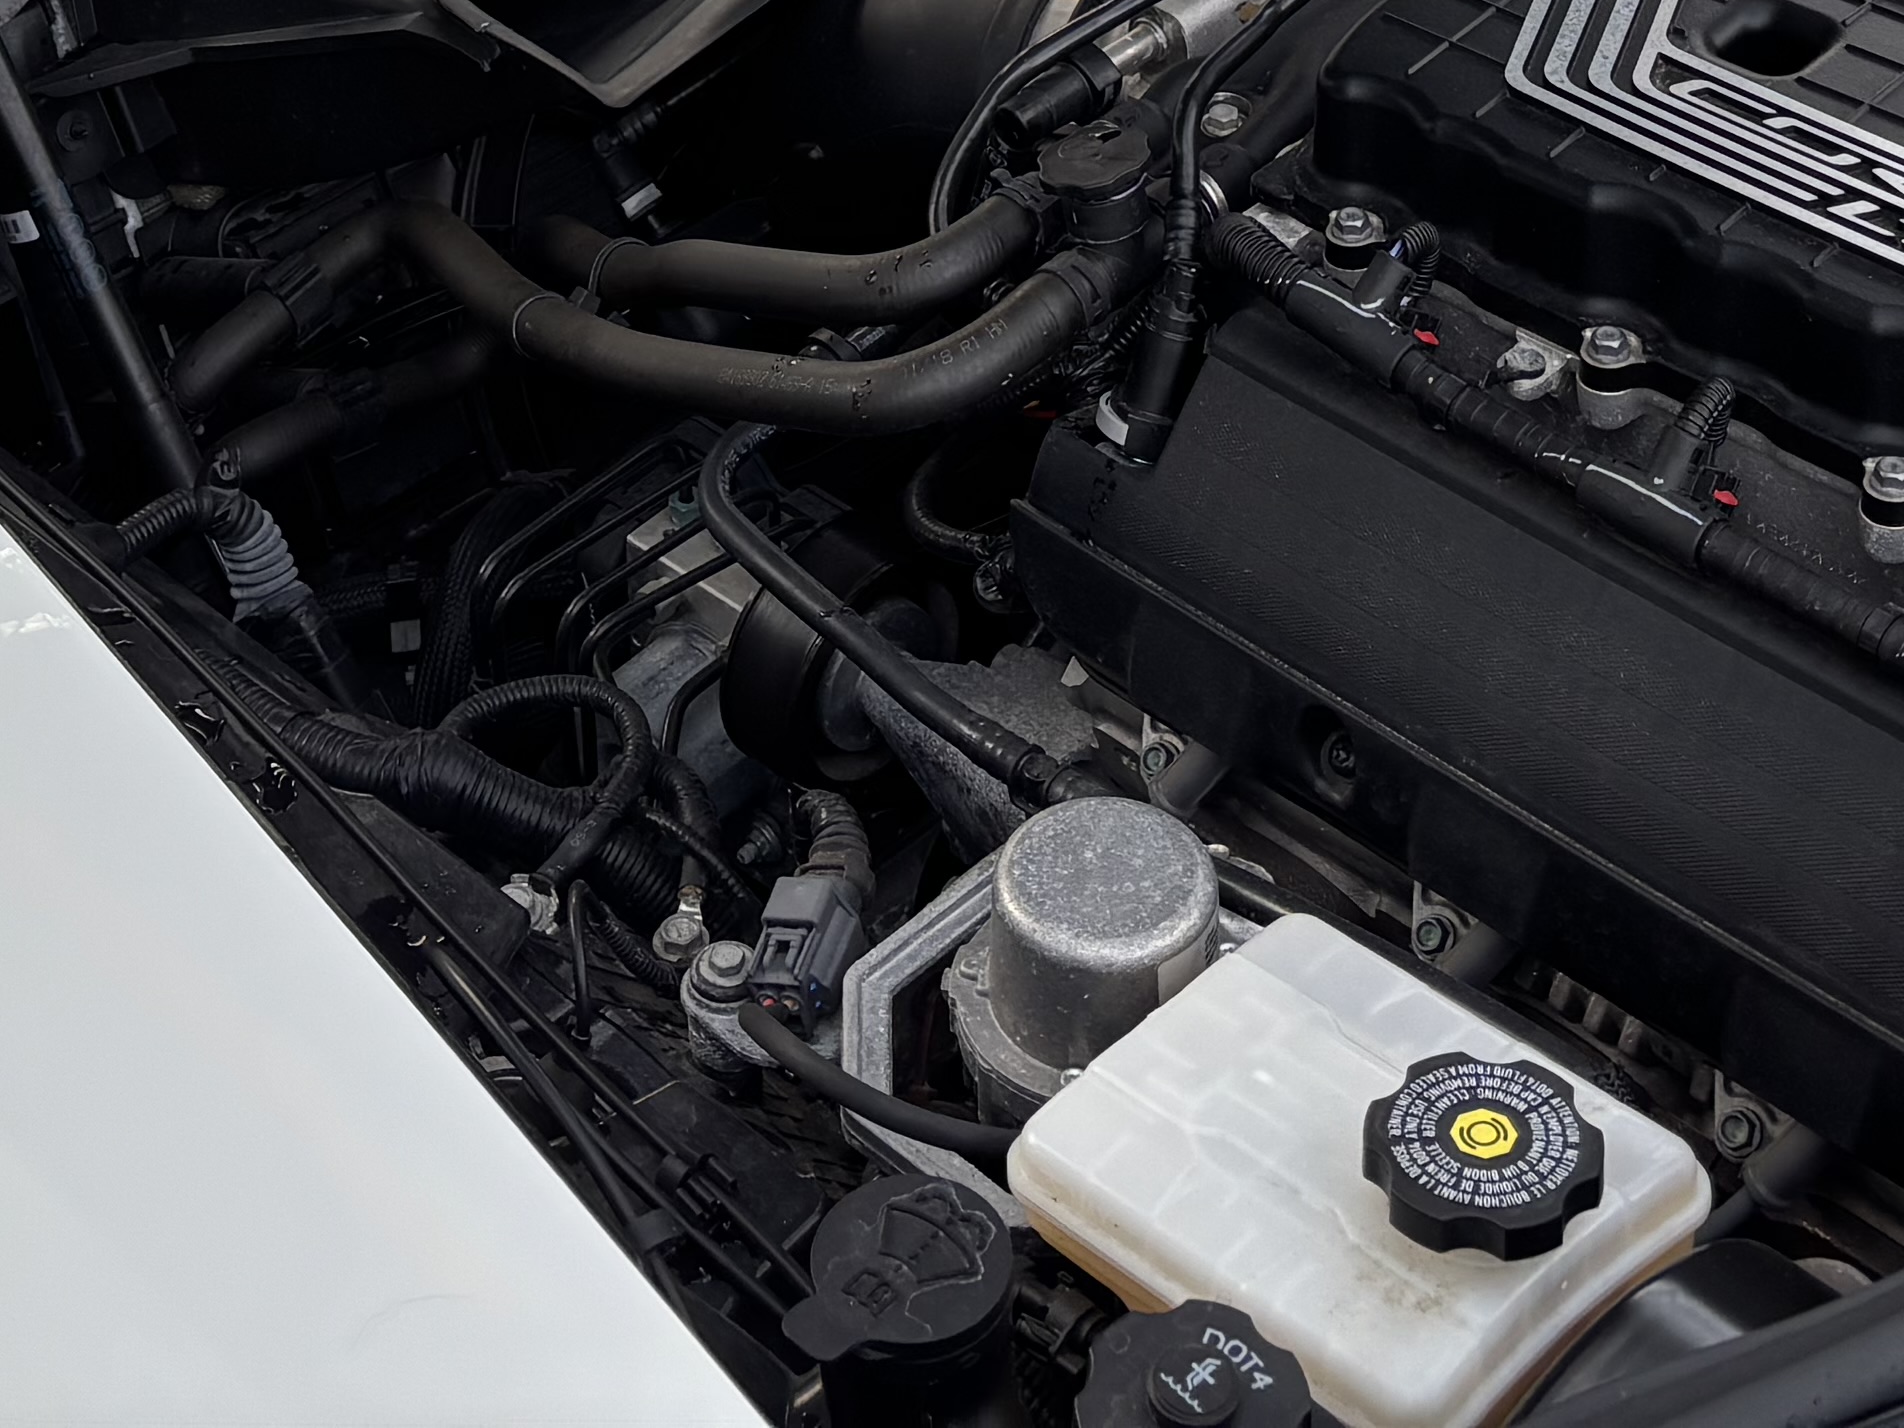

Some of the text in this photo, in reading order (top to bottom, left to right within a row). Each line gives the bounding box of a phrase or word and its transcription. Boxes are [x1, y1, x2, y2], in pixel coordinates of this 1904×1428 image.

[1448, 1065, 1457, 1076] A
[1458, 1064, 1490, 1075] FROM
[1494, 1065, 1527, 1083] FLUID
[1435, 1089, 1469, 1111] CLEAN
[1520, 1090, 1542, 1106] CAP
[1408, 1099, 1428, 1117] USE
[1418, 1174, 1436, 1190] LA
[1459, 1179, 1474, 1192] DE
[1433, 1184, 1472, 1204] AVANT
[1475, 1190, 1531, 1208] BOUCHON
[1530, 1184, 1546, 1198] LE
